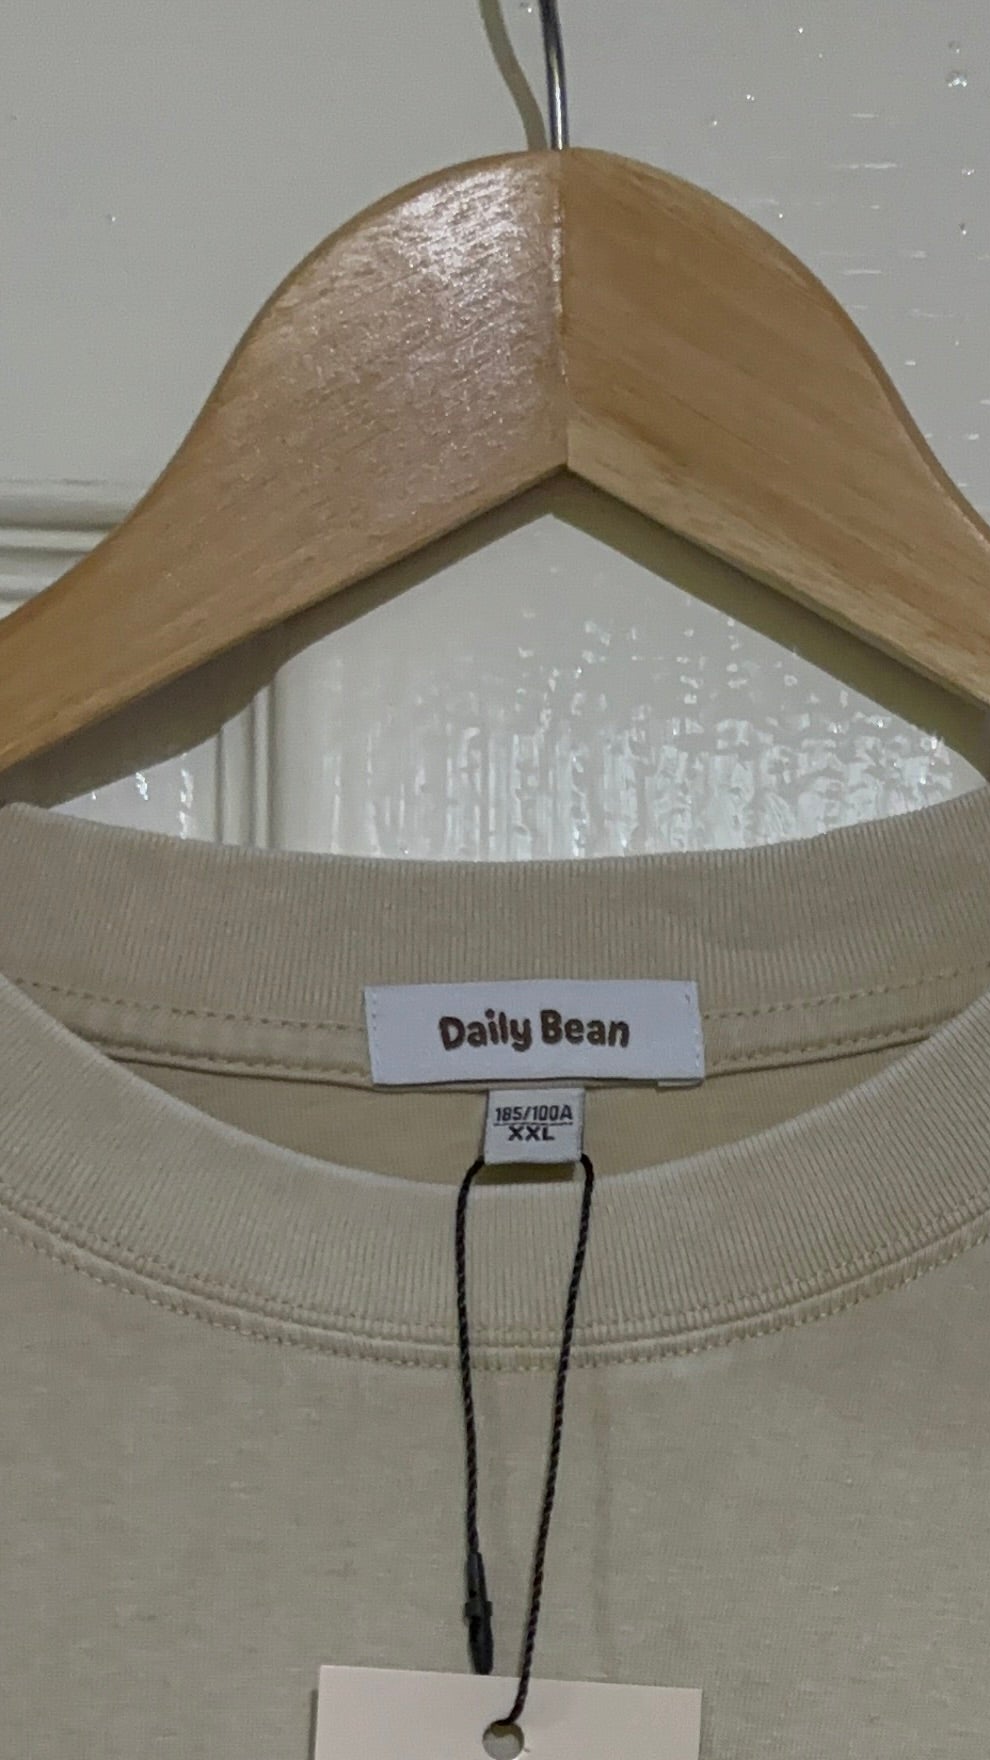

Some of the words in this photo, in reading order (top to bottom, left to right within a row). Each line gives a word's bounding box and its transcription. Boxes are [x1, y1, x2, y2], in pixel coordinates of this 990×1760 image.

[439, 1008, 533, 1051] Daily
[540, 1009, 630, 1049] Bean
[495, 1104, 574, 1122] 185/100A
[507, 1125, 556, 1142] XXL
